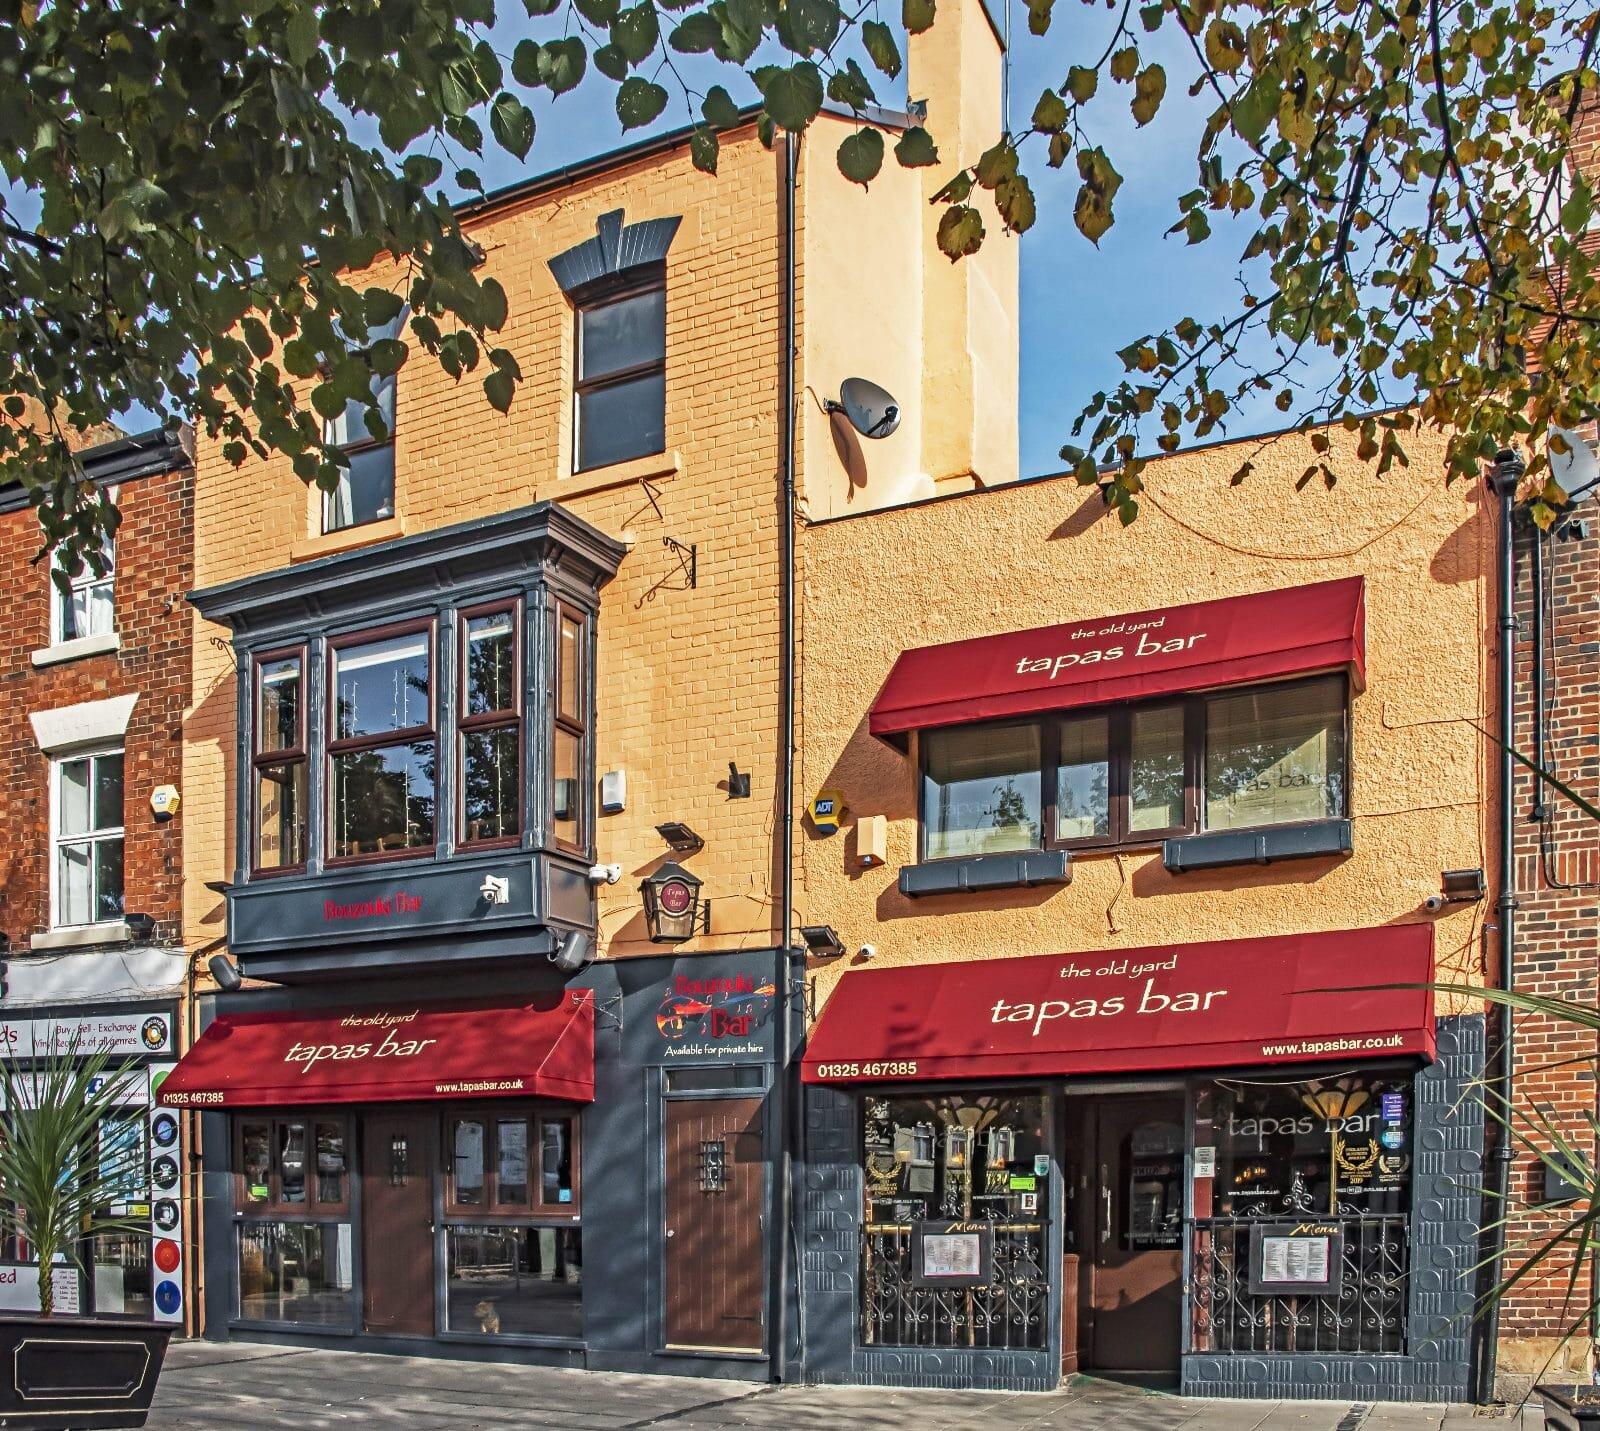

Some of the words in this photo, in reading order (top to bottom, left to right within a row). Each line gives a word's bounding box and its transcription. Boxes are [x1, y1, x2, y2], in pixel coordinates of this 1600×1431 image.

[1071, 628, 1096, 640] the
[1099, 622, 1125, 636] old
[1126, 616, 1166, 635] yard
[1015, 645, 1124, 680] tapas
[1134, 632, 1207, 658] bar
[815, 801, 833, 813] ADT
[1060, 963, 1091, 978] the
[1095, 959, 1129, 976] old
[1129, 954, 1178, 979] yard
[990, 995, 1125, 1037] tapas
[1136, 977, 1228, 1014] bar
[340, 1014, 362, 1026] the
[363, 1012, 388, 1025] old
[381, 1009, 420, 1029] yard
[711, 1008, 753, 1038] Bar
[56, 1025, 71, 1035] Buy
[78, 1023, 92, 1033] Sell
[98, 1022, 137, 1035] Exchange
[88, 1036, 97, 1047] of
[663, 1044, 703, 1057] Available
[704, 1043, 717, 1054] for
[718, 1044, 746, 1058] private
[747, 1042, 764, 1053] hire
[1262, 1034, 1404, 1056] www.tapasbar.co.uk
[284, 1042, 373, 1074] tapas
[373, 1028, 437, 1058] bar
[817, 1063, 859, 1077] 01325
[862, 1062, 917, 1077] 467385
[435, 1078, 524, 1095] www.tapasbar.co.uk
[163, 1093, 189, 1104] 01325
[190, 1092, 224, 1103] 467385
[1229, 1112, 1313, 1152] tapas
[945, 1222, 988, 1234] Menu
[1289, 1223, 1339, 1236] Menu
